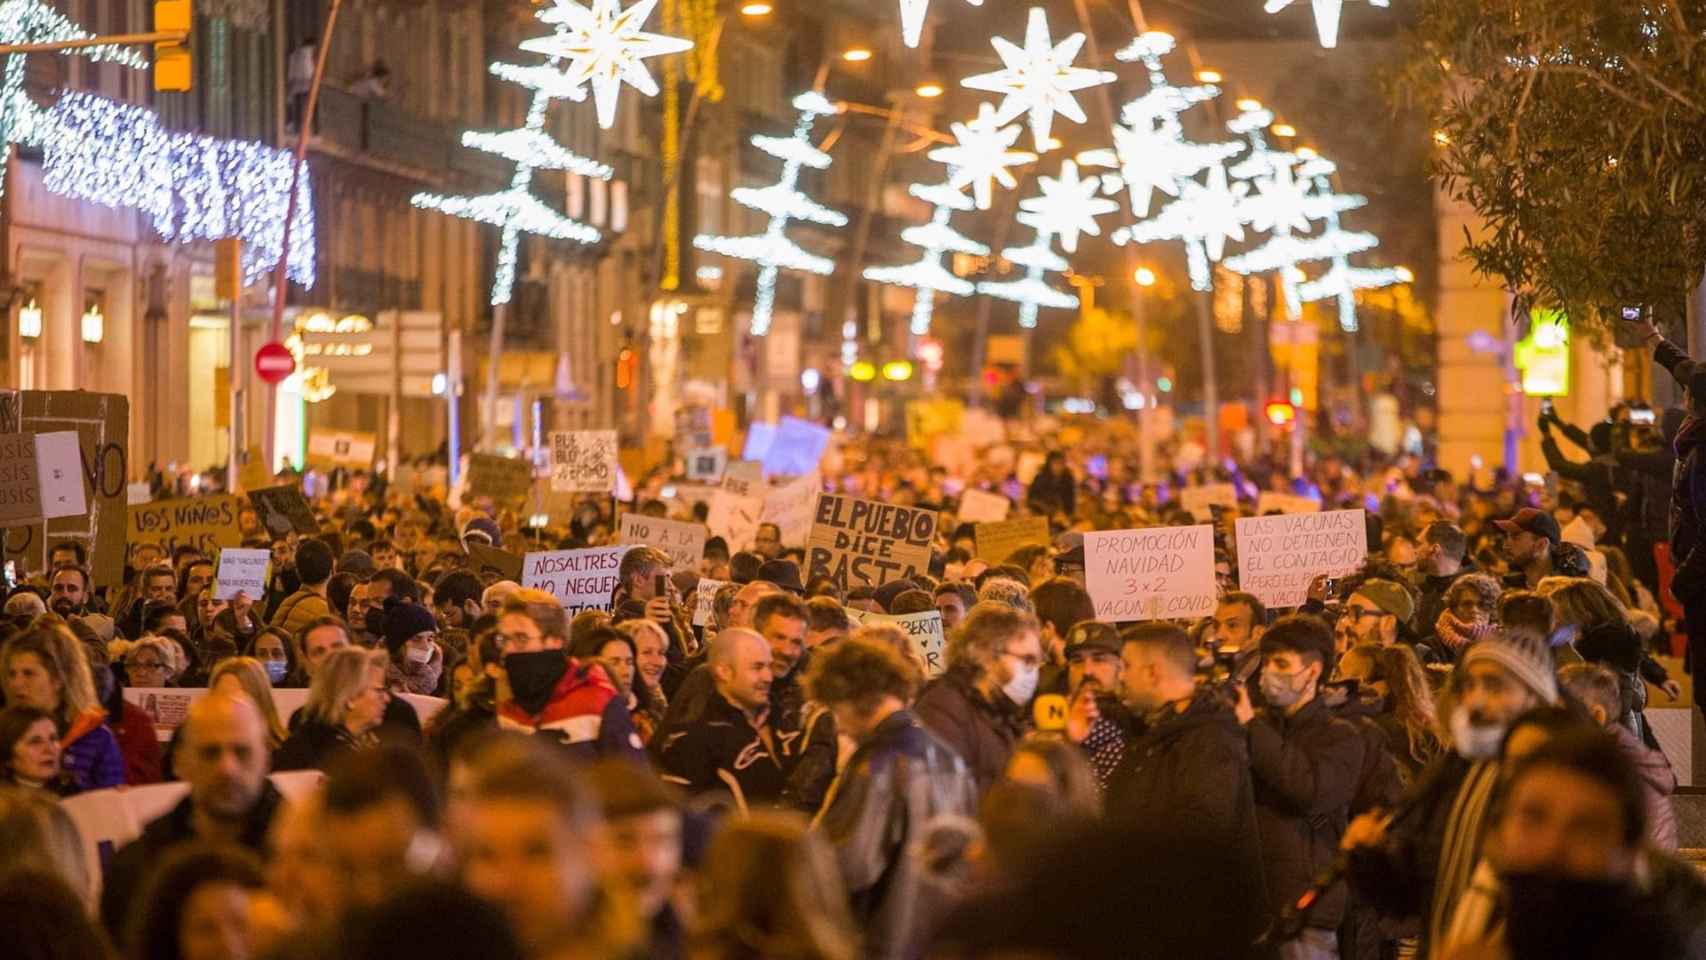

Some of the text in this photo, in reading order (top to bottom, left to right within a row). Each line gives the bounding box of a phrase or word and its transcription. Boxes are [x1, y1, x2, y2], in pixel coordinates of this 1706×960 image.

[816, 495, 846, 528] EL
[848, 500, 933, 547] PUEBLO
[1243, 511, 1354, 537] LAS VACUNAS
[629, 523, 694, 546] NO A LA
[1096, 529, 1199, 553] PROMOCIÓN
[1248, 531, 1360, 553] NO DETIENEN
[533, 551, 619, 576] NOSALTRES
[1106, 554, 1185, 575] NAVIDAD
[1247, 547, 1359, 572] EL CONTAGIO
[1097, 594, 1213, 616] VACUN COVID
[1048, 704, 1064, 720] N
